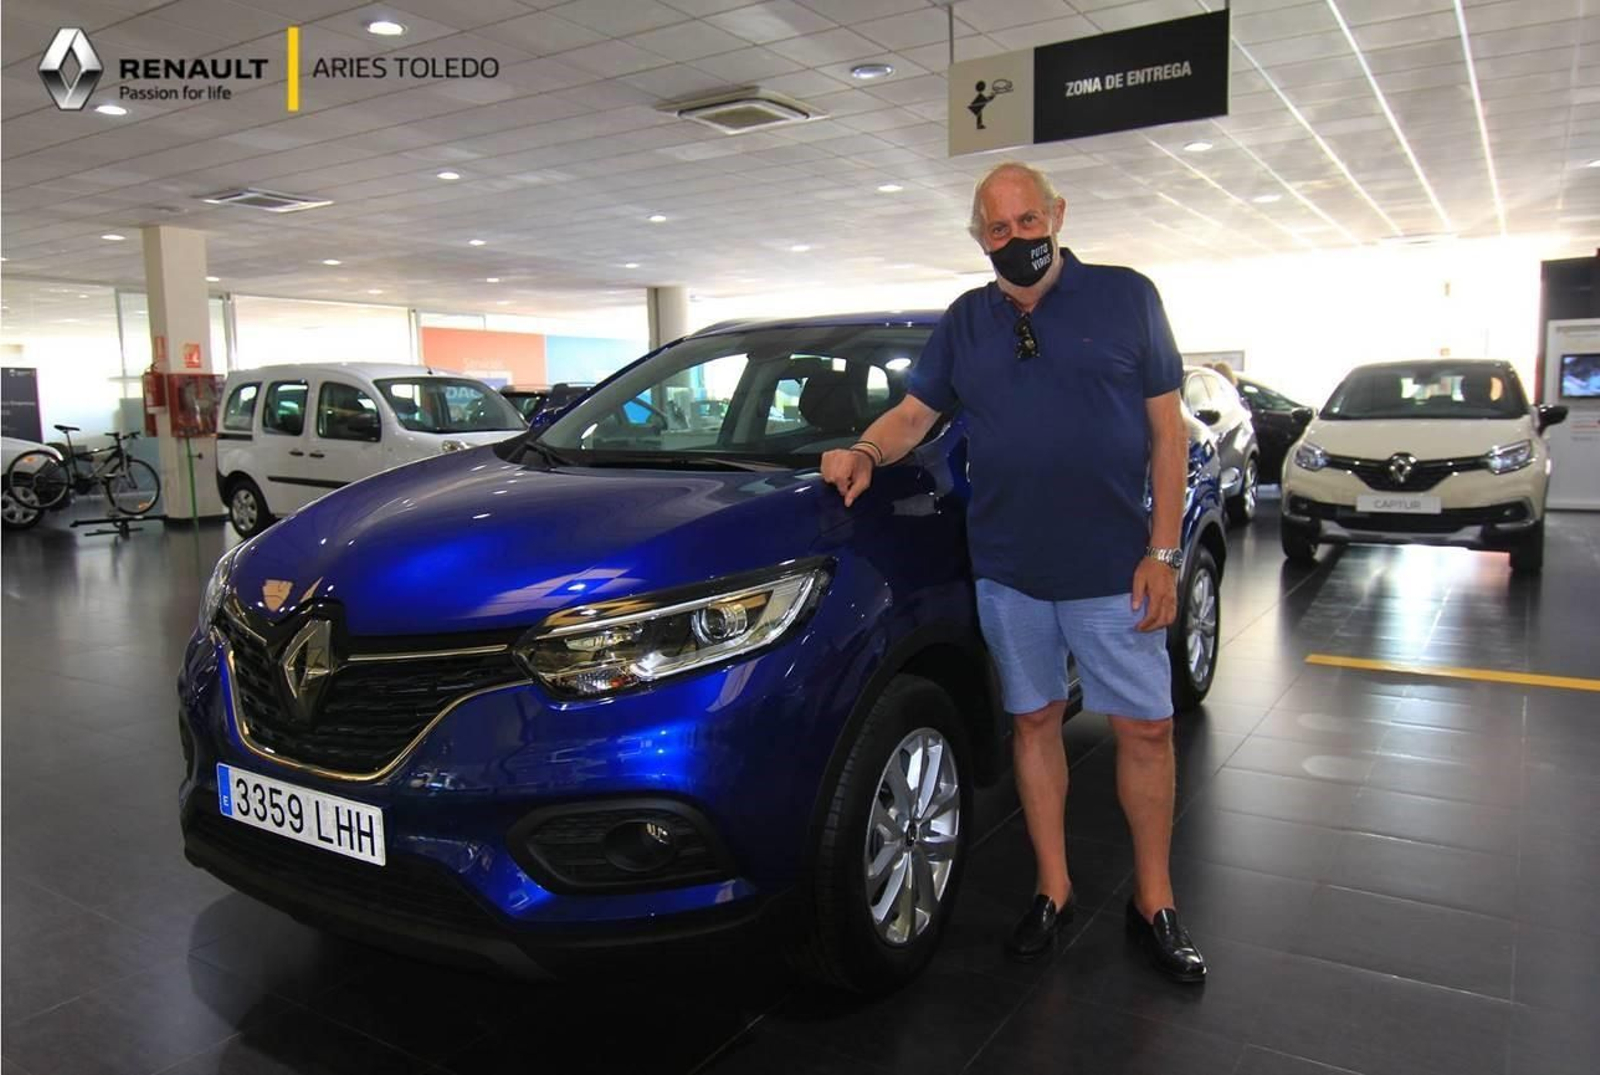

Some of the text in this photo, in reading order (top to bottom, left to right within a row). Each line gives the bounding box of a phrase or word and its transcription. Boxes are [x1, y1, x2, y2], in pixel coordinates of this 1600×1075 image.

[1065, 61, 1192, 97] ZONA DE ENTREGA
[1373, 499, 1422, 510] CAPTUR
[235, 778, 304, 834] 3359
[314, 800, 376, 856] LHH
